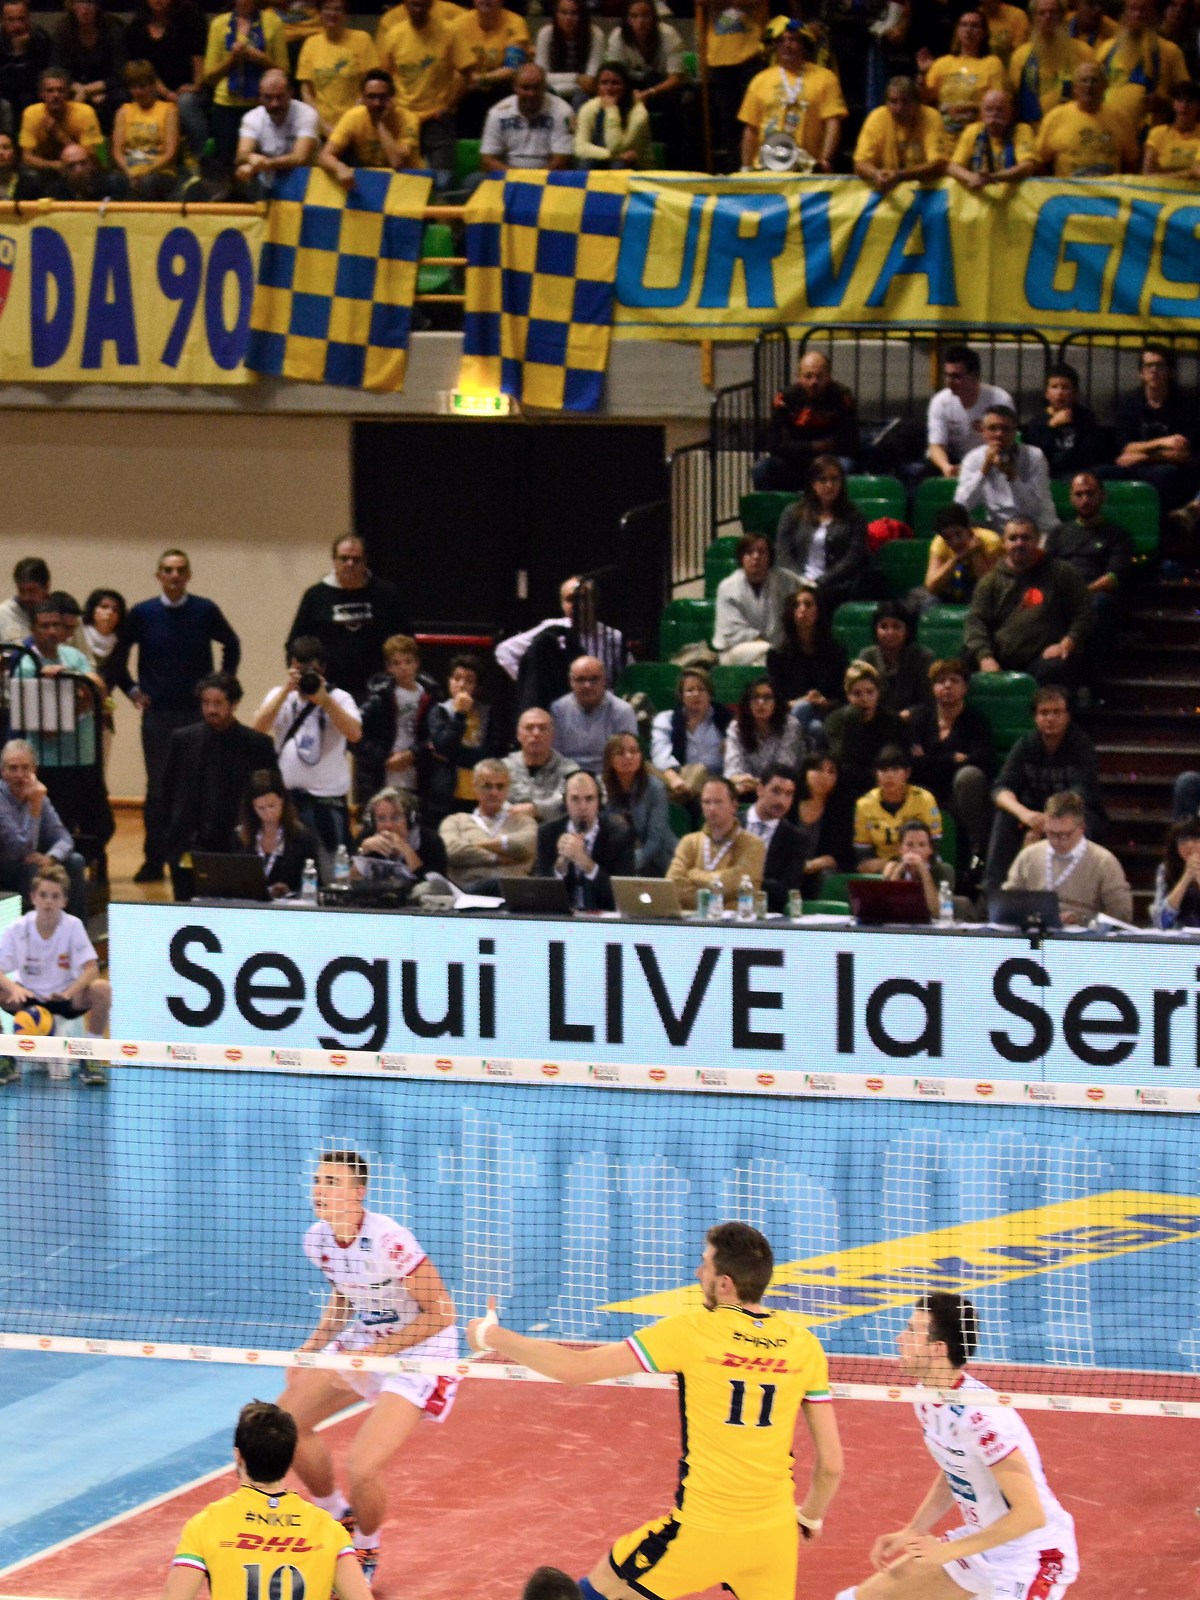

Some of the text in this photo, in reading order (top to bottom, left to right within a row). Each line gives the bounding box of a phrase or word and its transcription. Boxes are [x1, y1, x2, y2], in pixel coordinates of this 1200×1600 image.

[30, 226, 140, 369] DA
[157, 226, 253, 370] 90
[166, 925, 1200, 1067] Segui LIVE la Ser
[721, 1352, 788, 1374] DHL
[724, 1379, 777, 1428] 11
[235, 1532, 313, 1554] DHL
[242, 1563, 306, 1600] 10
